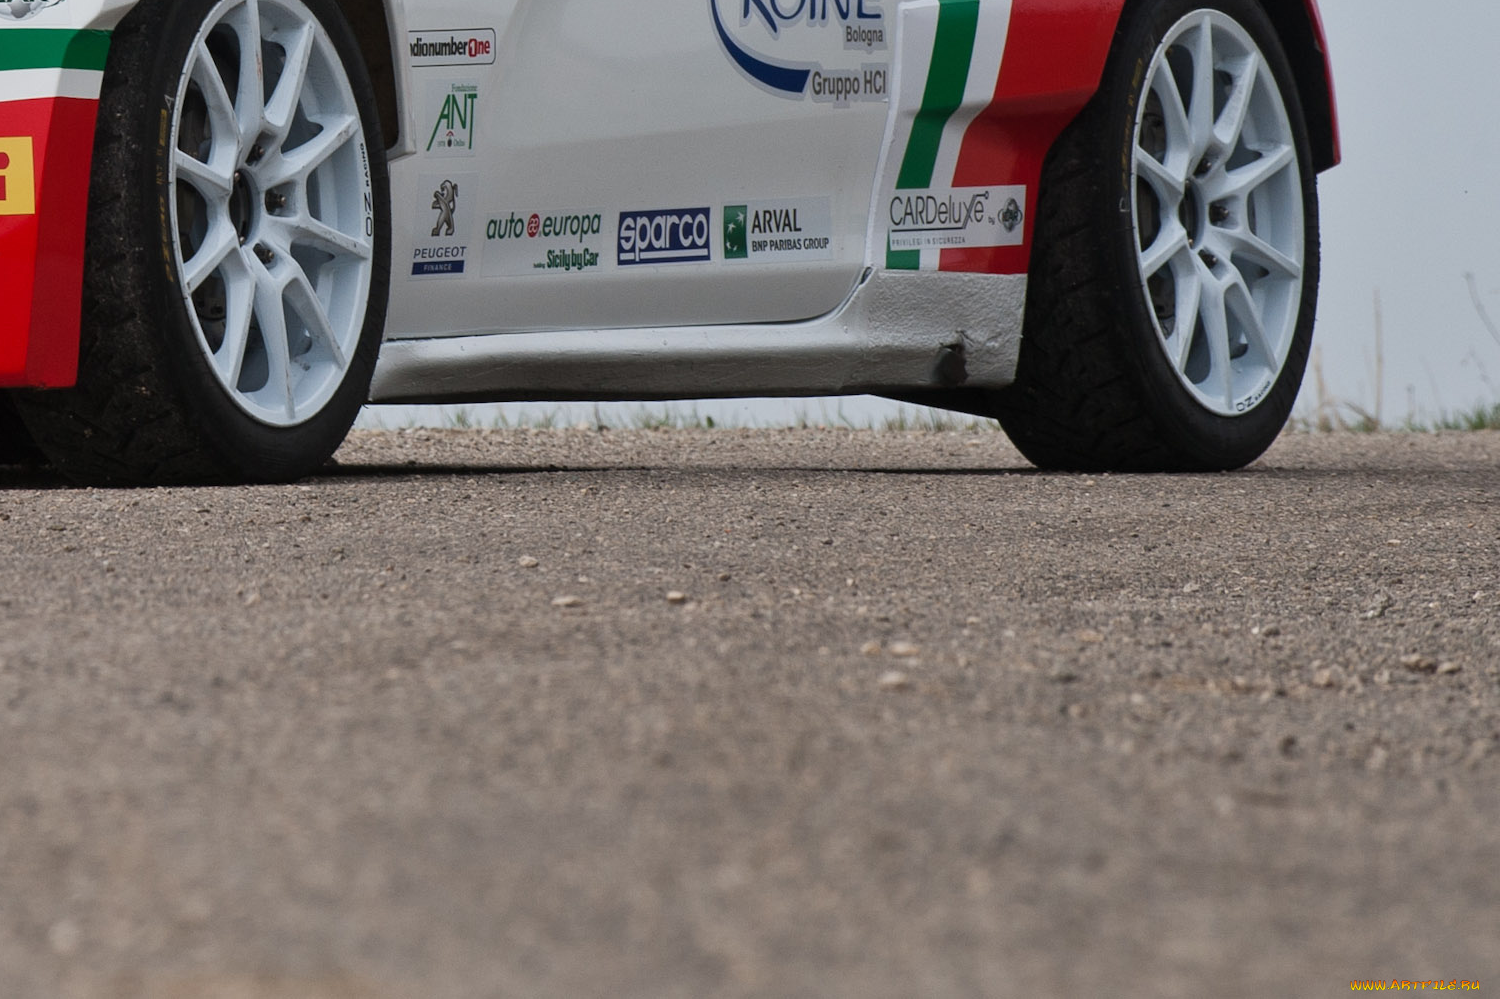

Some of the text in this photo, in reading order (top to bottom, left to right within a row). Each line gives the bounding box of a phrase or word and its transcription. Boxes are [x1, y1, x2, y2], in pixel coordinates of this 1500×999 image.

[846, 25, 884, 47] Bologna
[812, 70, 886, 101] Gruppo HCI
[426, 93, 478, 152] ANT
[486, 211, 524, 240] auto
[542, 213, 602, 243] europa
[751, 208, 802, 235] ARVAL
[619, 213, 709, 262] sparco
[752, 237, 830, 253] BNP PARIBAS GROUP
[413, 246, 467, 259] PEUGEOT
